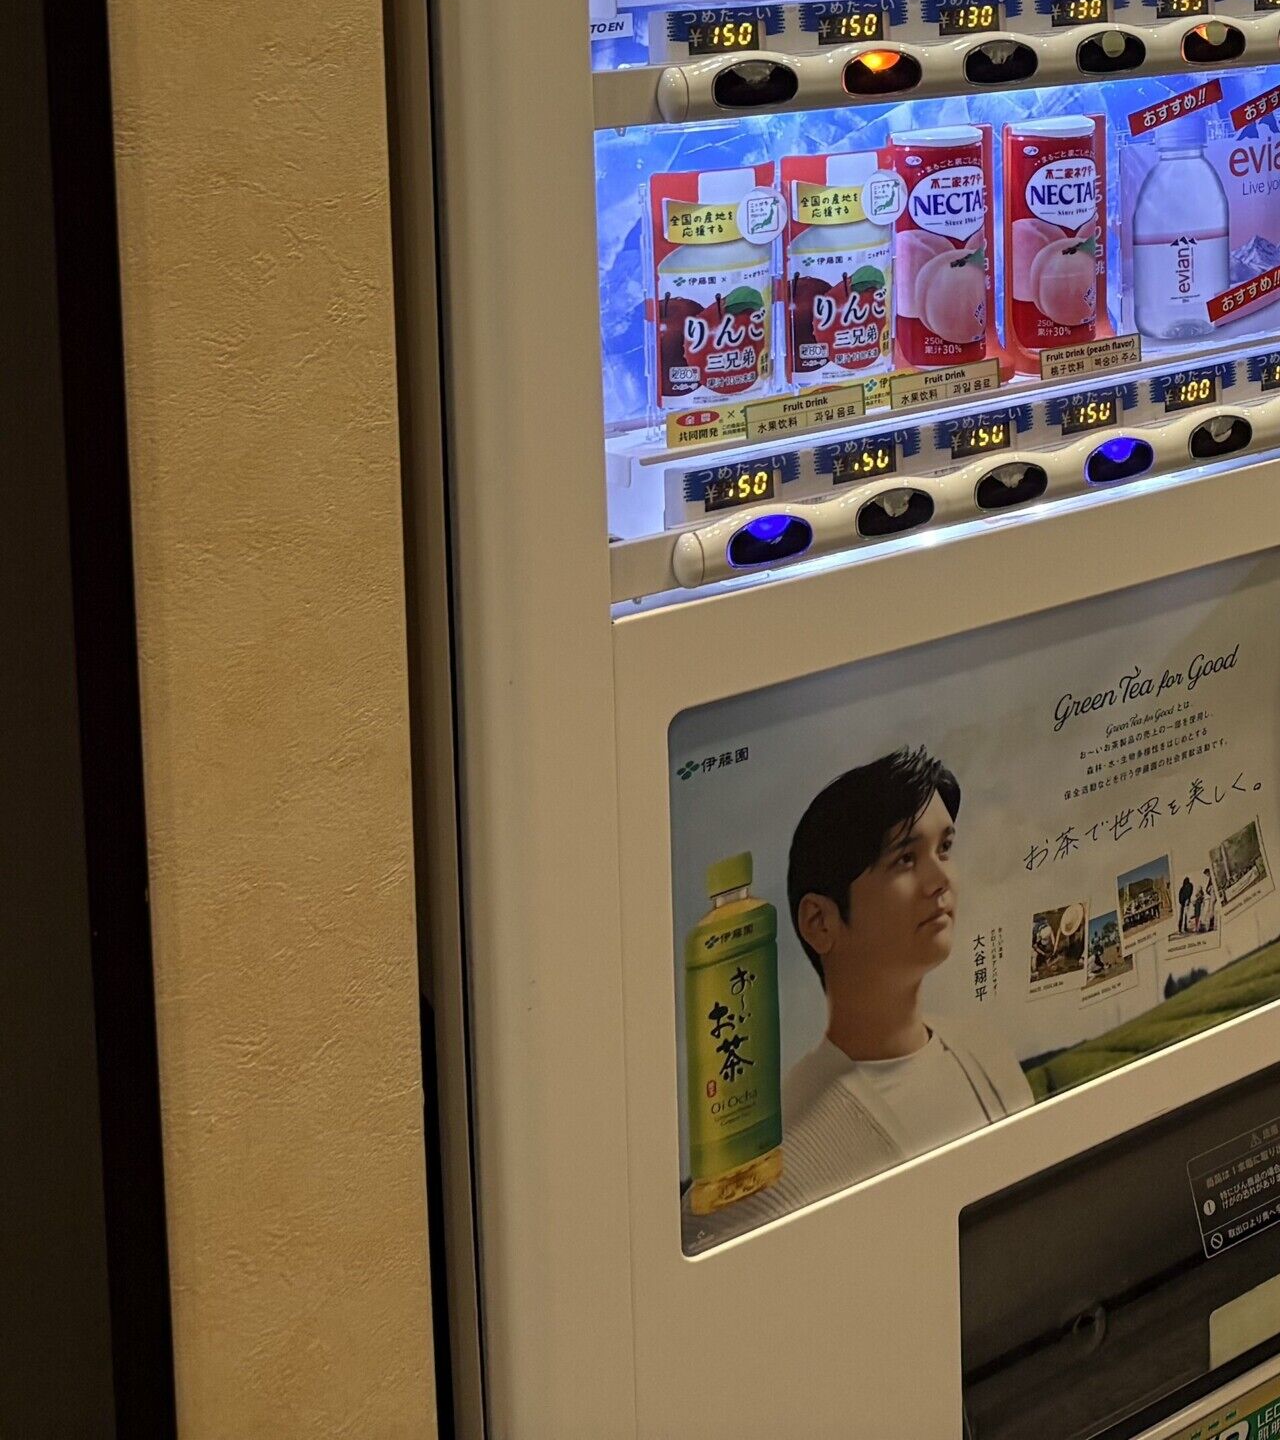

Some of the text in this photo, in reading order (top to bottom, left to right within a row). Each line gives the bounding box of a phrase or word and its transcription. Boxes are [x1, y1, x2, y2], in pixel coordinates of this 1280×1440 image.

[841, 14, 878, 36] 150
[958, 6, 992, 28] 130
[712, 23, 752, 45] 150
[800, 192, 859, 206] 全国の産地を
[671, 211, 734, 225] 全国の産地を
[812, 206, 849, 218] 応援する
[682, 224, 723, 237] 応援する
[815, 289, 886, 327] りんご
[687, 310, 765, 351] りんご
[835, 327, 878, 348] 三兄弟
[708, 349, 754, 371] 三兄弟
[1047, 338, 1135, 362] Fruit Drink (peach flavor)
[925, 370, 965, 385] Fruit Drink
[1180, 380, 1210, 401] 100
[783, 397, 828, 412] Fruit Drink
[679, 427, 718, 442] 共同開発
[1054, 644, 1240, 732] Green Tea for Good
[701, 747, 749, 773] 伊藤園
[721, 924, 754, 945] 伊藤園
[973, 933, 988, 1002] 大谷翔平
